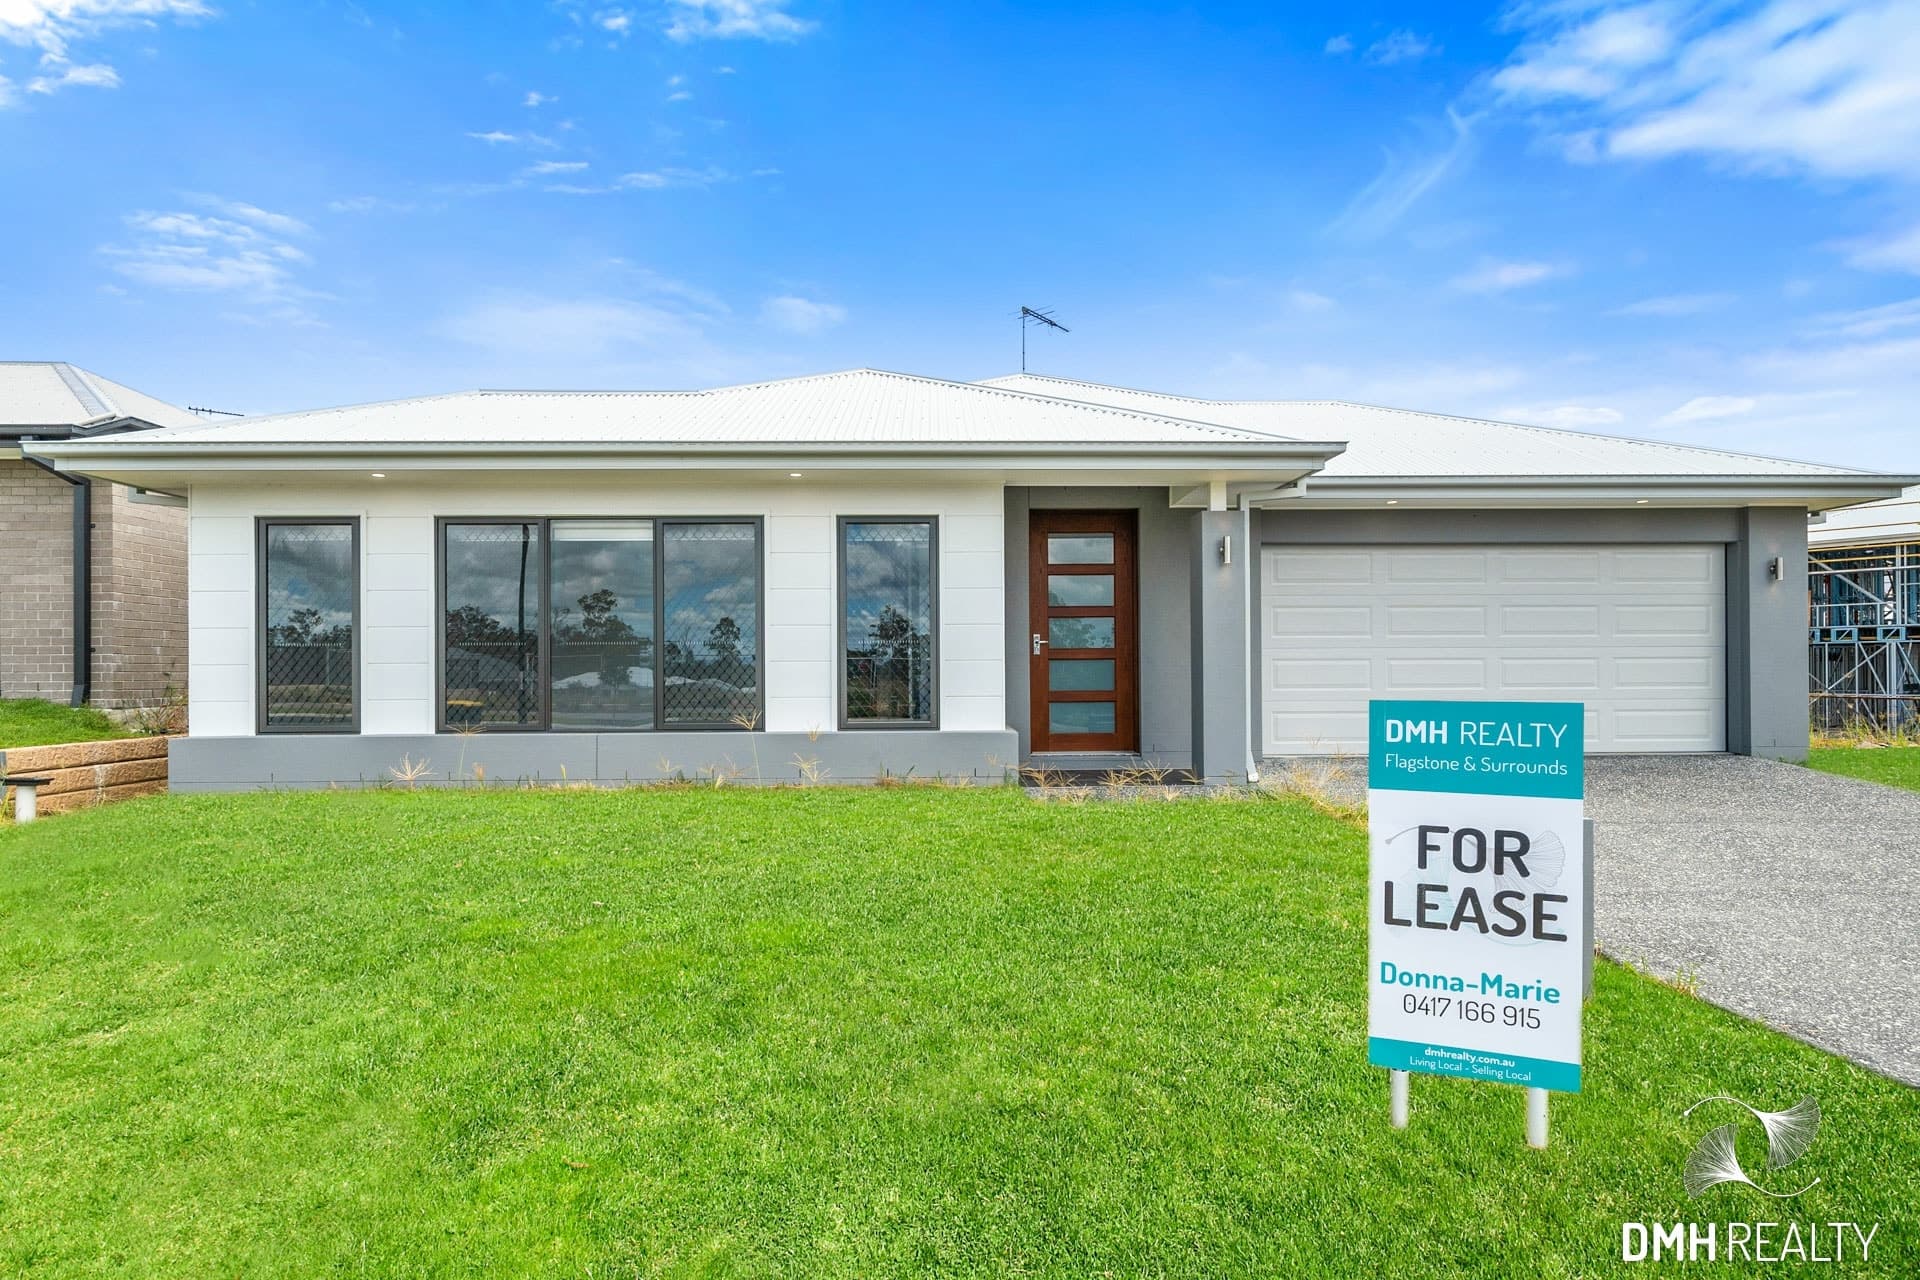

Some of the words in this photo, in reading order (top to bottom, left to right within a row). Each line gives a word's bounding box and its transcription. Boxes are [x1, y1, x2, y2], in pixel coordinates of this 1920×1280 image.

[1385, 719, 1448, 744] DMH
[1460, 721, 1568, 748] REALTY
[1385, 754, 1460, 773] Flagstone
[1463, 756, 1477, 771] &
[1481, 757, 1568, 775] Surrounds
[1417, 825, 1531, 878] FOR
[1384, 881, 1568, 942] LEASE
[1380, 961, 1560, 1004] Donna-Marie
[1403, 994, 1451, 1017] 0417
[1457, 1000, 1495, 1023] 166
[1503, 1005, 1541, 1029] 915
[1409, 1055, 1436, 1071] Living
[1438, 1058, 1462, 1072] Local
[1471, 1064, 1503, 1080] Selling
[1505, 1069, 1531, 1081] Local
[1424, 1047, 1515, 1067] dmhrealty.com.au
